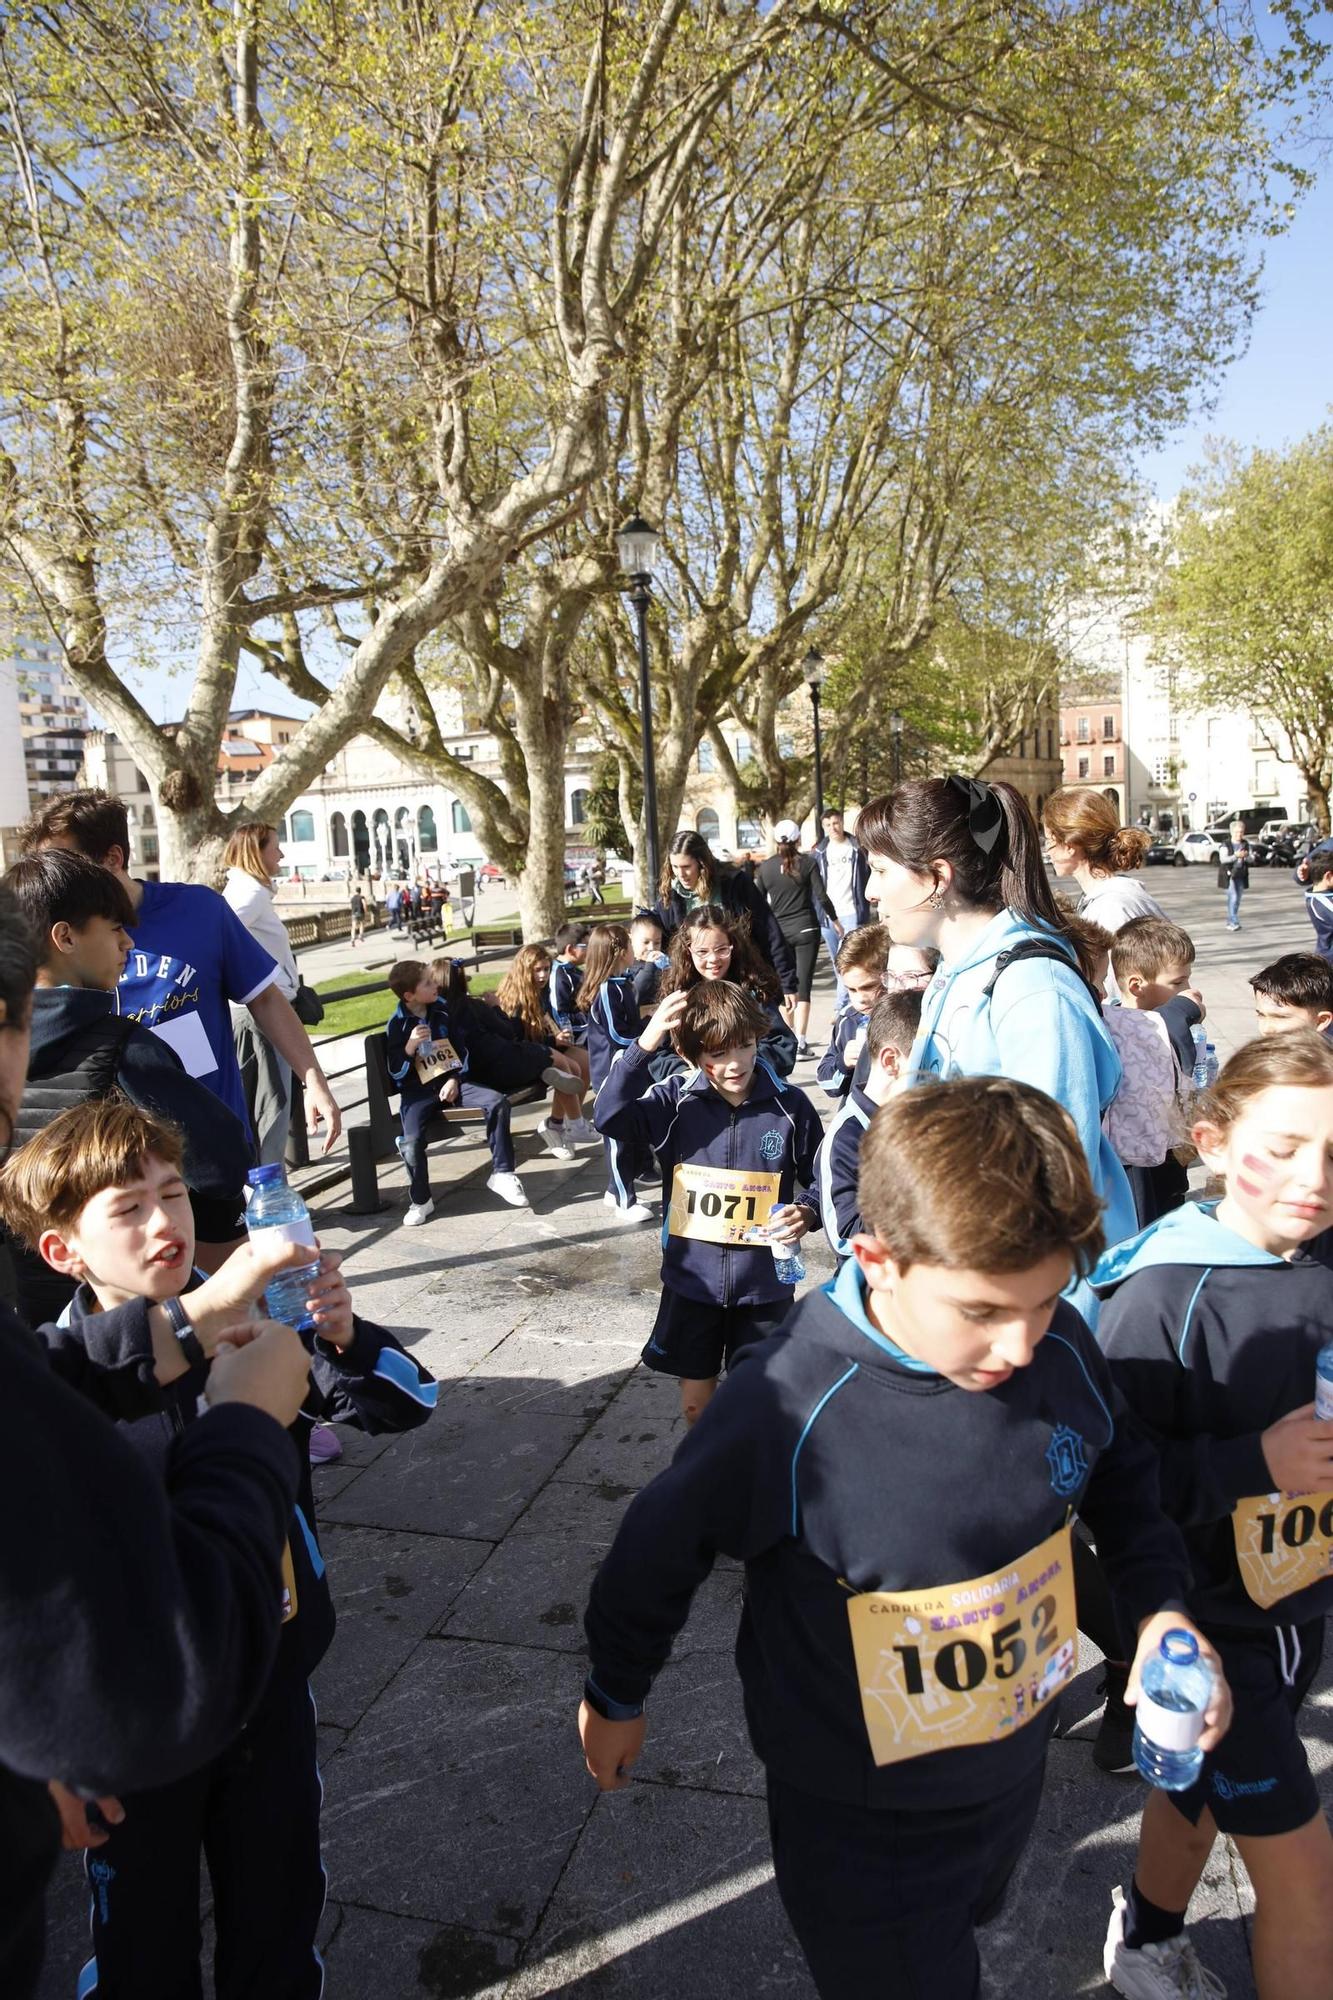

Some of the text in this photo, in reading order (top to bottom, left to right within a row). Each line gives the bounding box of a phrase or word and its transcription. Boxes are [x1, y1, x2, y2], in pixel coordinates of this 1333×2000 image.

[119, 953, 197, 988] DEN
[420, 1049, 454, 1070] 1062
[686, 1189, 756, 1221] 1071
[869, 1571, 1020, 1615] CARRERA SOLIDARIA
[929, 1559, 1063, 1633] SANTO ANGEL
[892, 1593, 1059, 1697] 1052
